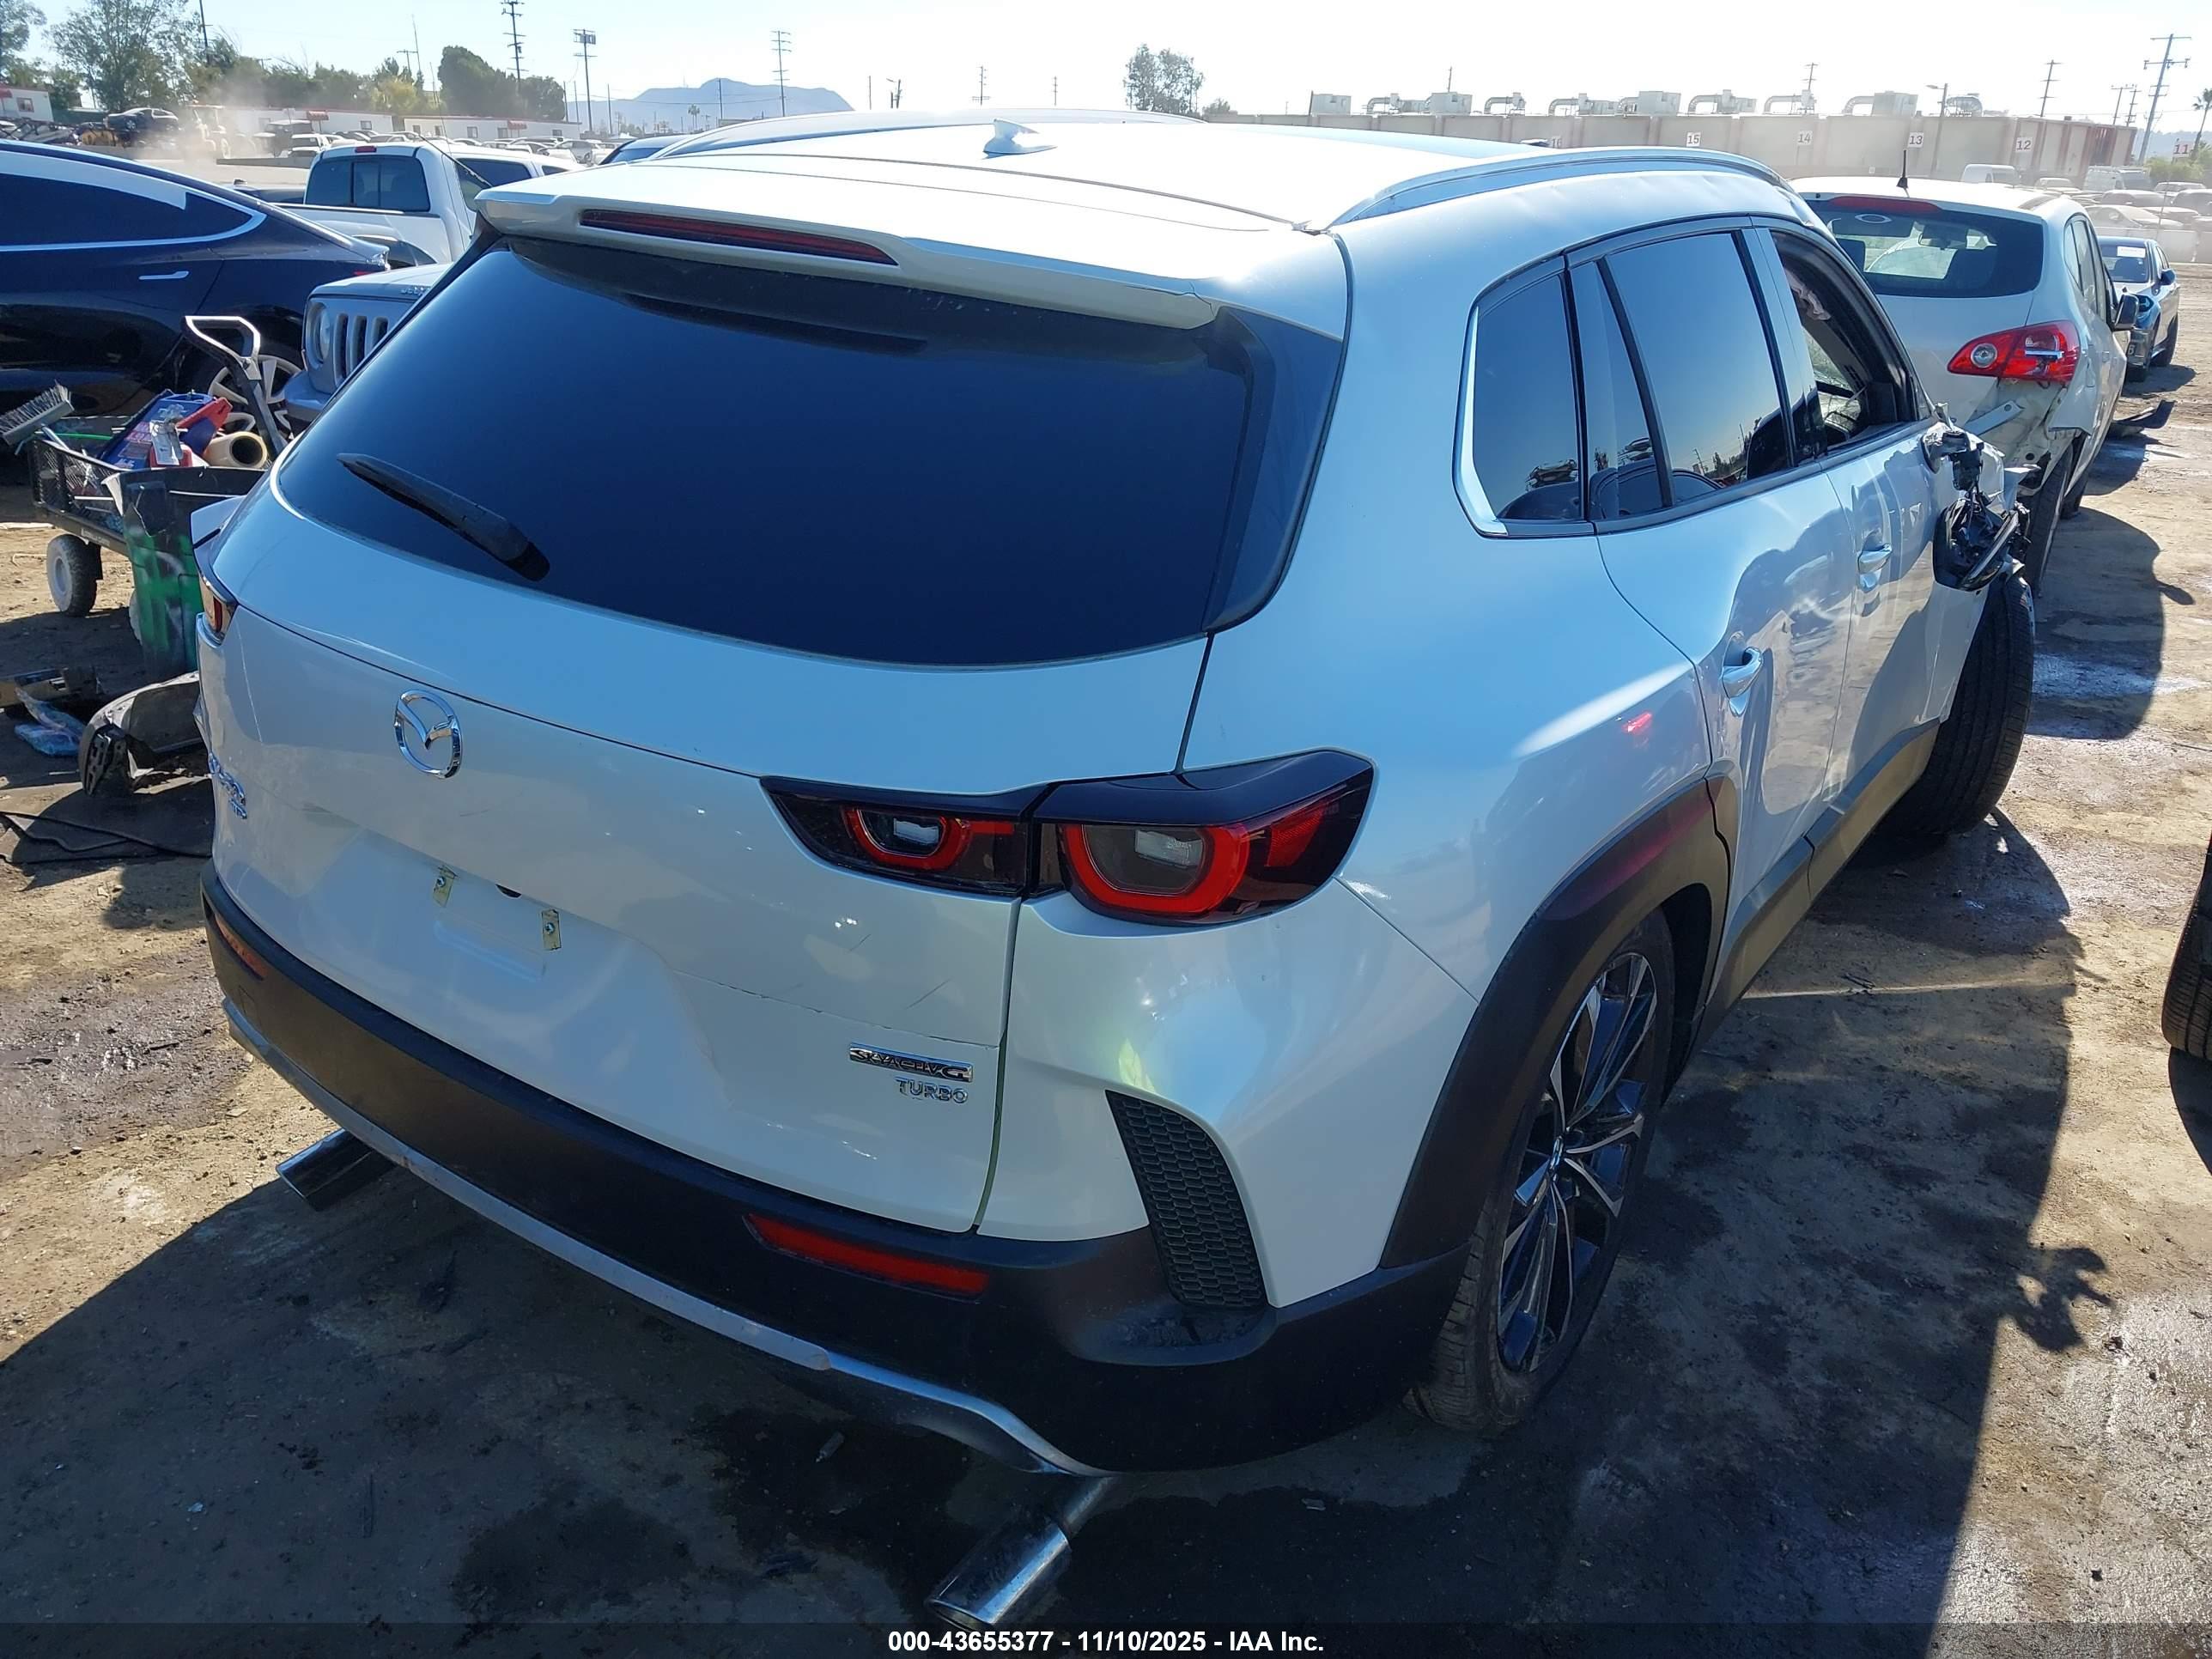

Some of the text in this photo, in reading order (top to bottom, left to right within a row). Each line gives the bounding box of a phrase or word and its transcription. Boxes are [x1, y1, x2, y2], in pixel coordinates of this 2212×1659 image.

[1686, 134, 1700, 144] 15
[1797, 133, 1812, 143] 14
[1908, 135, 1923, 145] 13
[2015, 140, 2032, 151] 12
[2172, 143, 2189, 155] 11
[895, 1076, 969, 1104] TURBO
